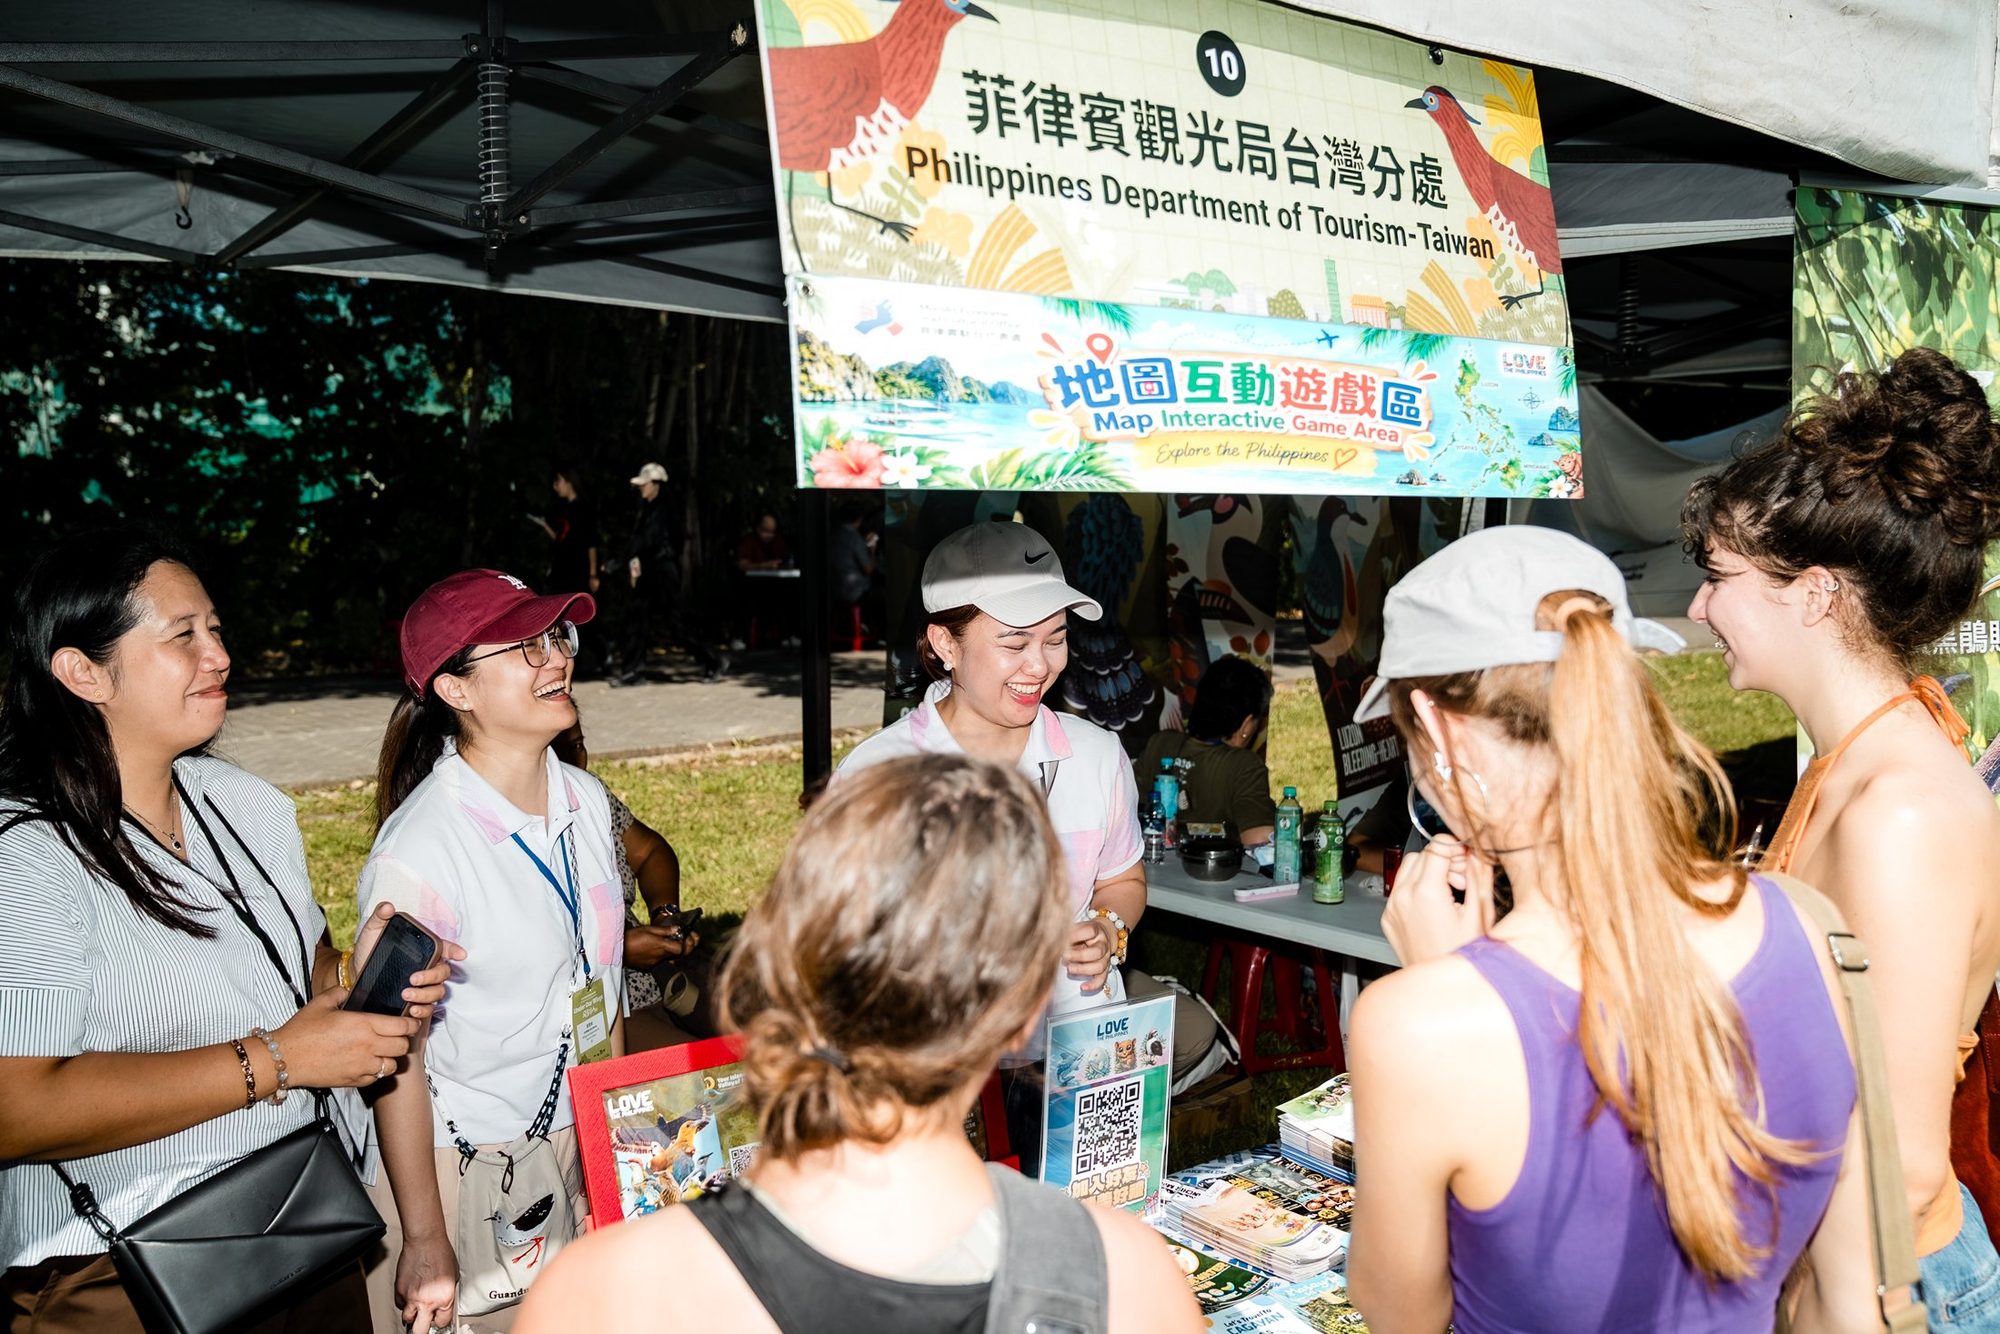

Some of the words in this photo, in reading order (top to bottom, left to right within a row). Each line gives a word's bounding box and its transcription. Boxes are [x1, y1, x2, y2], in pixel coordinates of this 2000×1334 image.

[1205, 47, 1239, 81] 10
[962, 69, 1448, 209] 菲律賓觀光局台灣分處
[906, 146, 1092, 201] Philippines
[1102, 174, 1270, 228] Department
[1278, 202, 1302, 231] of
[1308, 205, 1495, 260] Tourism-Taiwan
[1503, 352, 1546, 369] LOVE
[1053, 357, 1422, 426] 地圖互動遊戲區
[1094, 412, 1153, 433] Map
[1162, 410, 1285, 430] Interactive
[1292, 415, 1347, 436] Game
[1354, 422, 1399, 443] Area
[1157, 443, 1210, 464] Explore
[1216, 441, 1240, 457] the
[1246, 443, 1327, 463] Philippines
[1337, 723, 1364, 751] LUZON
[1097, 1017, 1129, 1036] LOVE
[607, 1090, 654, 1113] LOVE
[1224, 1318, 1242, 1327] Let's
[1226, 1312, 1285, 1334] CAGAYAN
